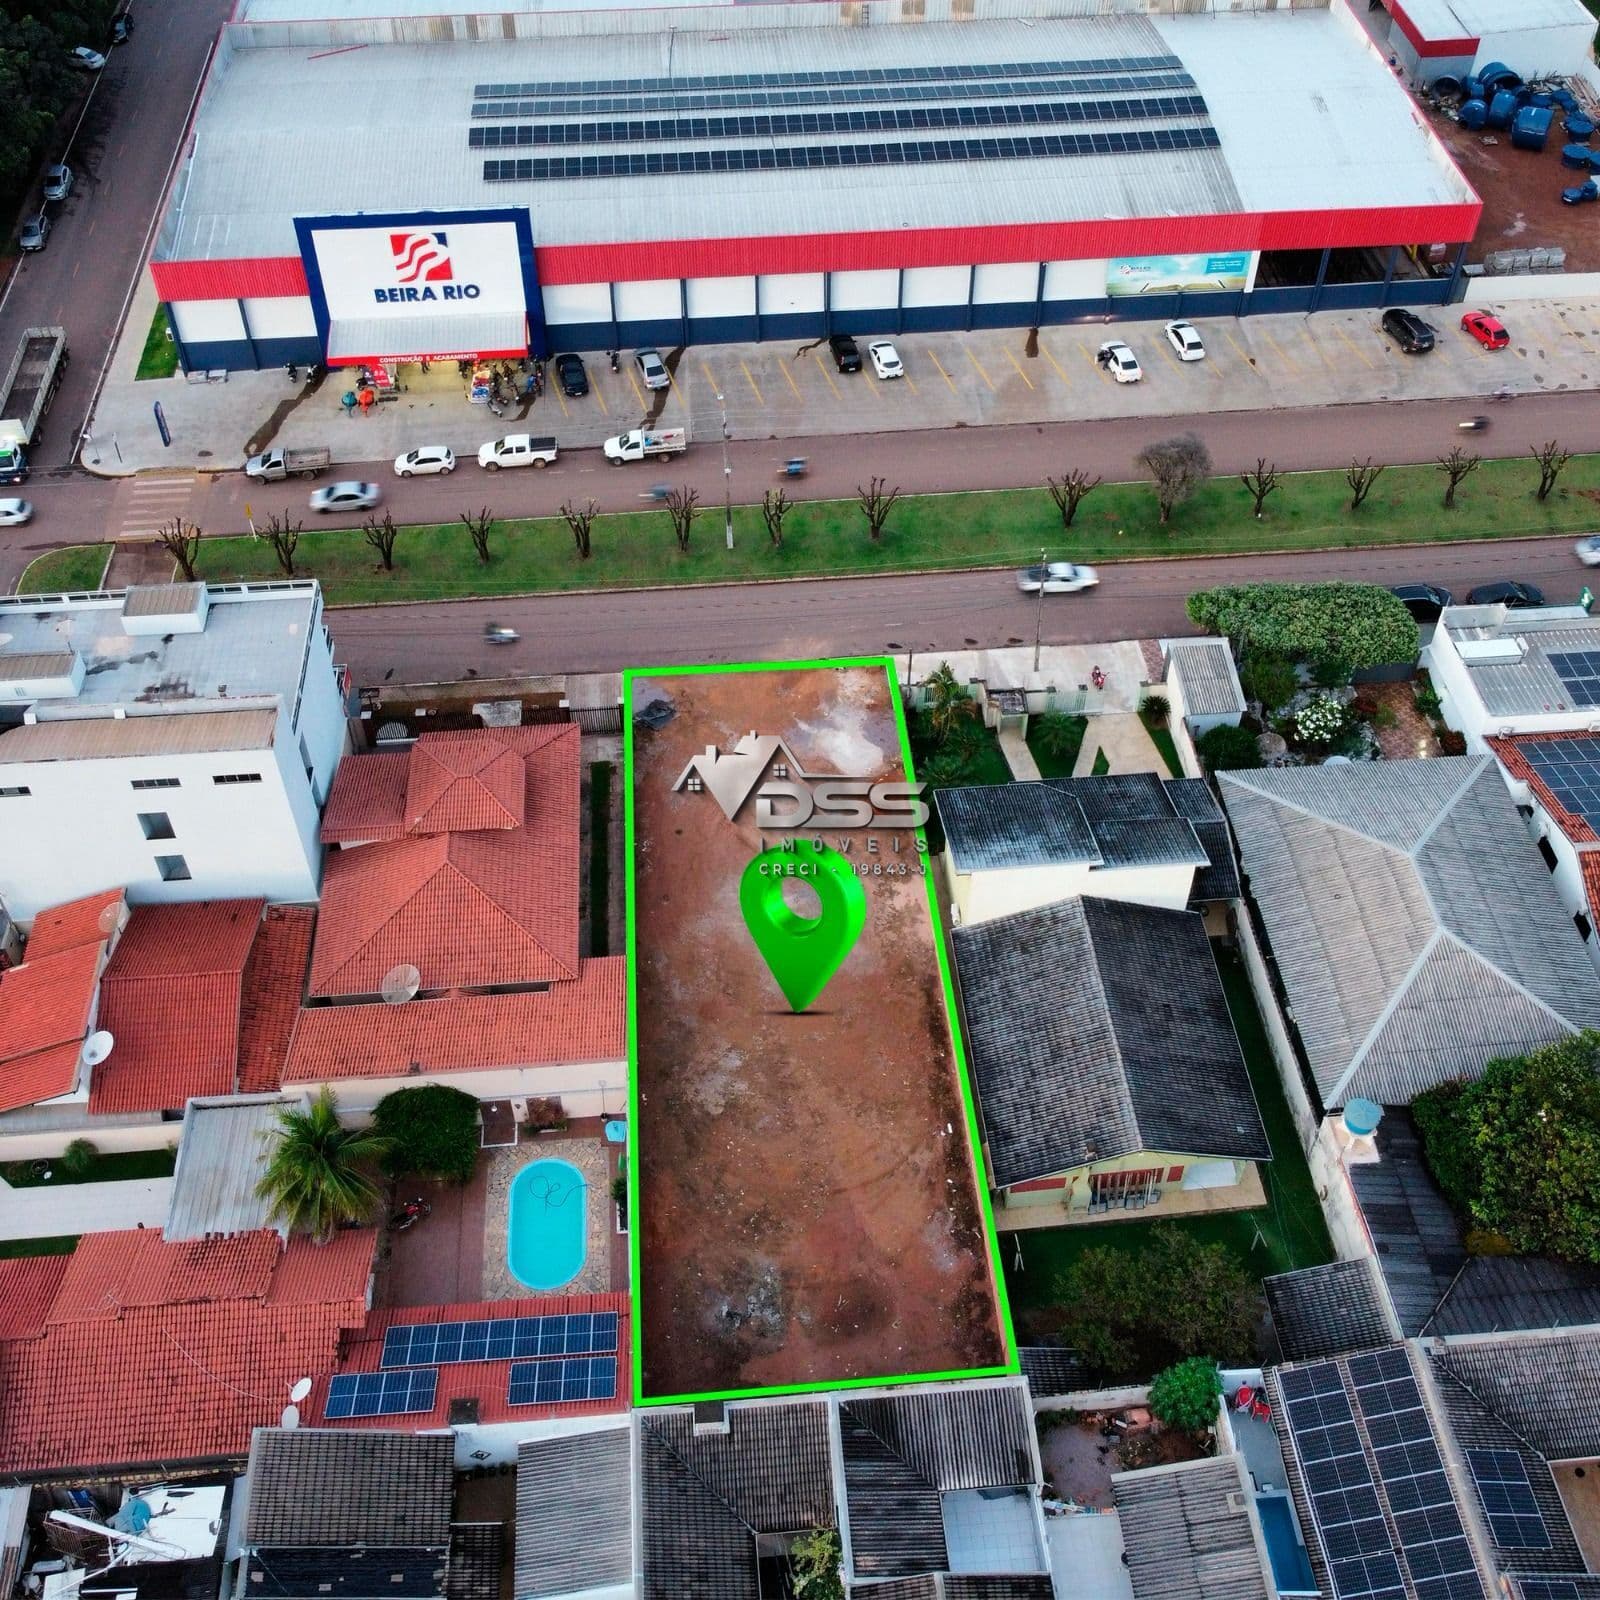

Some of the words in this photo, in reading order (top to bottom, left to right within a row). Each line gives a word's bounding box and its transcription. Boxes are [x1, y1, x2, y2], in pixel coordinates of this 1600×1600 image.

[374, 287, 437, 303] BEIRA
[443, 285, 480, 300] RIO
[379, 355, 423, 364] CONSTRUÇÃO
[433, 353, 478, 361] ACABAMENTO
